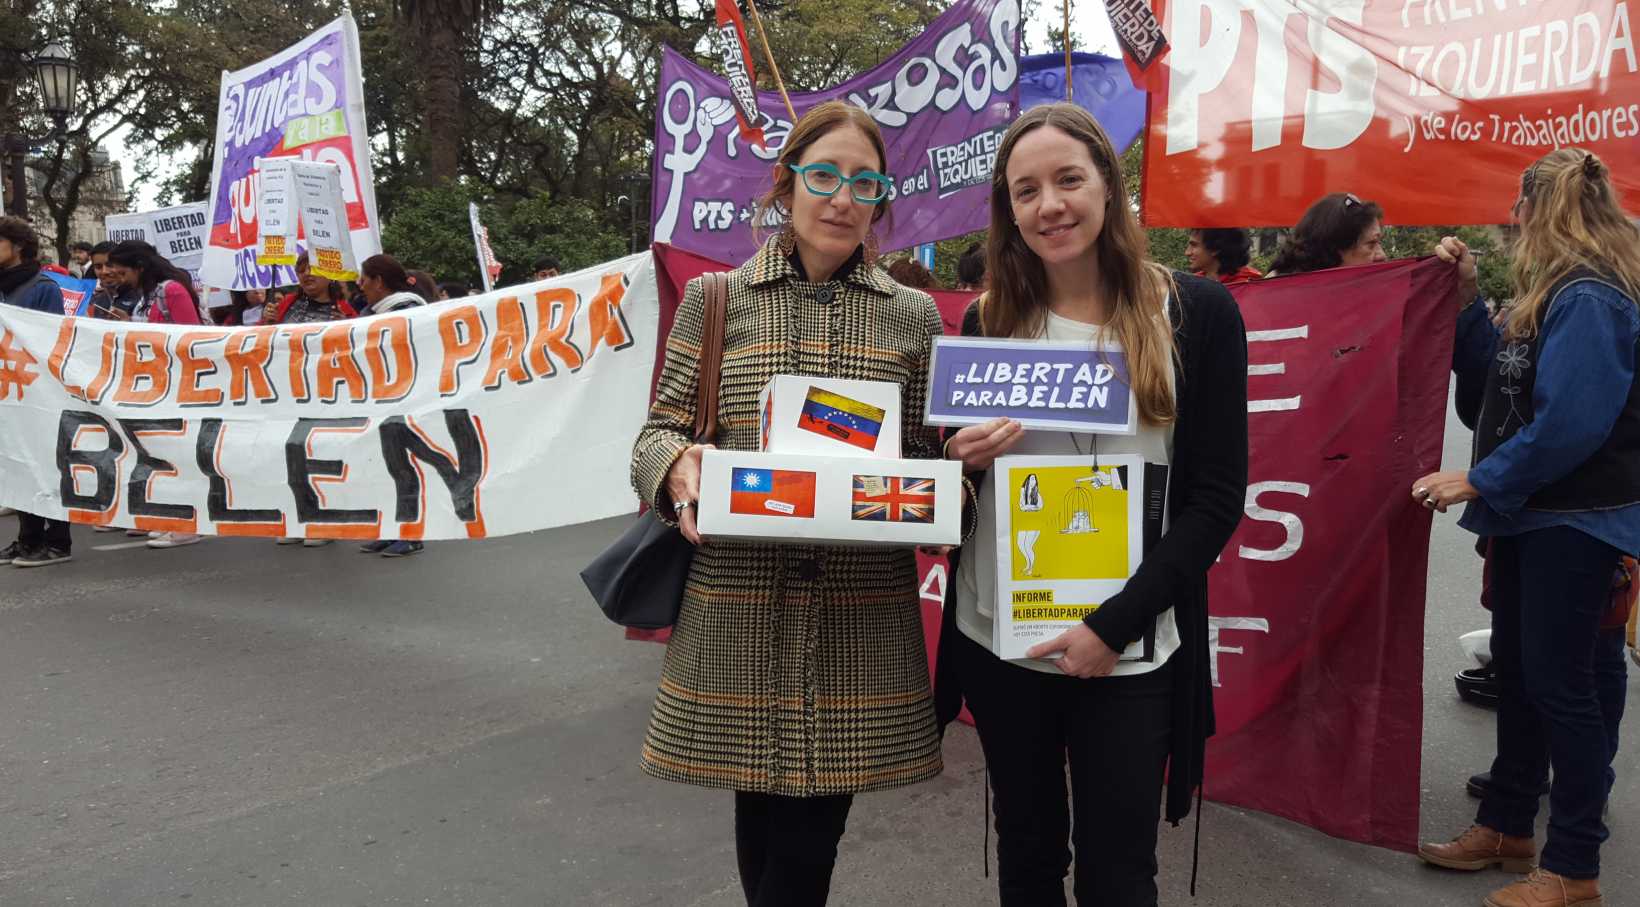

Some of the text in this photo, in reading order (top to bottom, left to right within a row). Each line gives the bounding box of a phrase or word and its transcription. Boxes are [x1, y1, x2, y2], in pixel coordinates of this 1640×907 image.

[1398, 2, 1638, 99] IZQUIERDA
[1166, 0, 1378, 156] PTS
[1403, 103, 1640, 153] y de los Trabajadores
[937, 130, 994, 168] FRENTE
[901, 177, 915, 196] en
[917, 169, 929, 190] el
[939, 152, 996, 188] IZQUIER
[154, 212, 206, 233] LIBERTAD
[693, 201, 734, 230] PTS
[109, 228, 146, 243] LIBERTAD
[169, 235, 203, 254] BELEN
[0, 271, 634, 407] #LIBERTAD PARA
[954, 362, 1114, 385] #LIBERTAD
[56, 407, 489, 539] BELEN
[1012, 591, 1053, 602] INFORME
